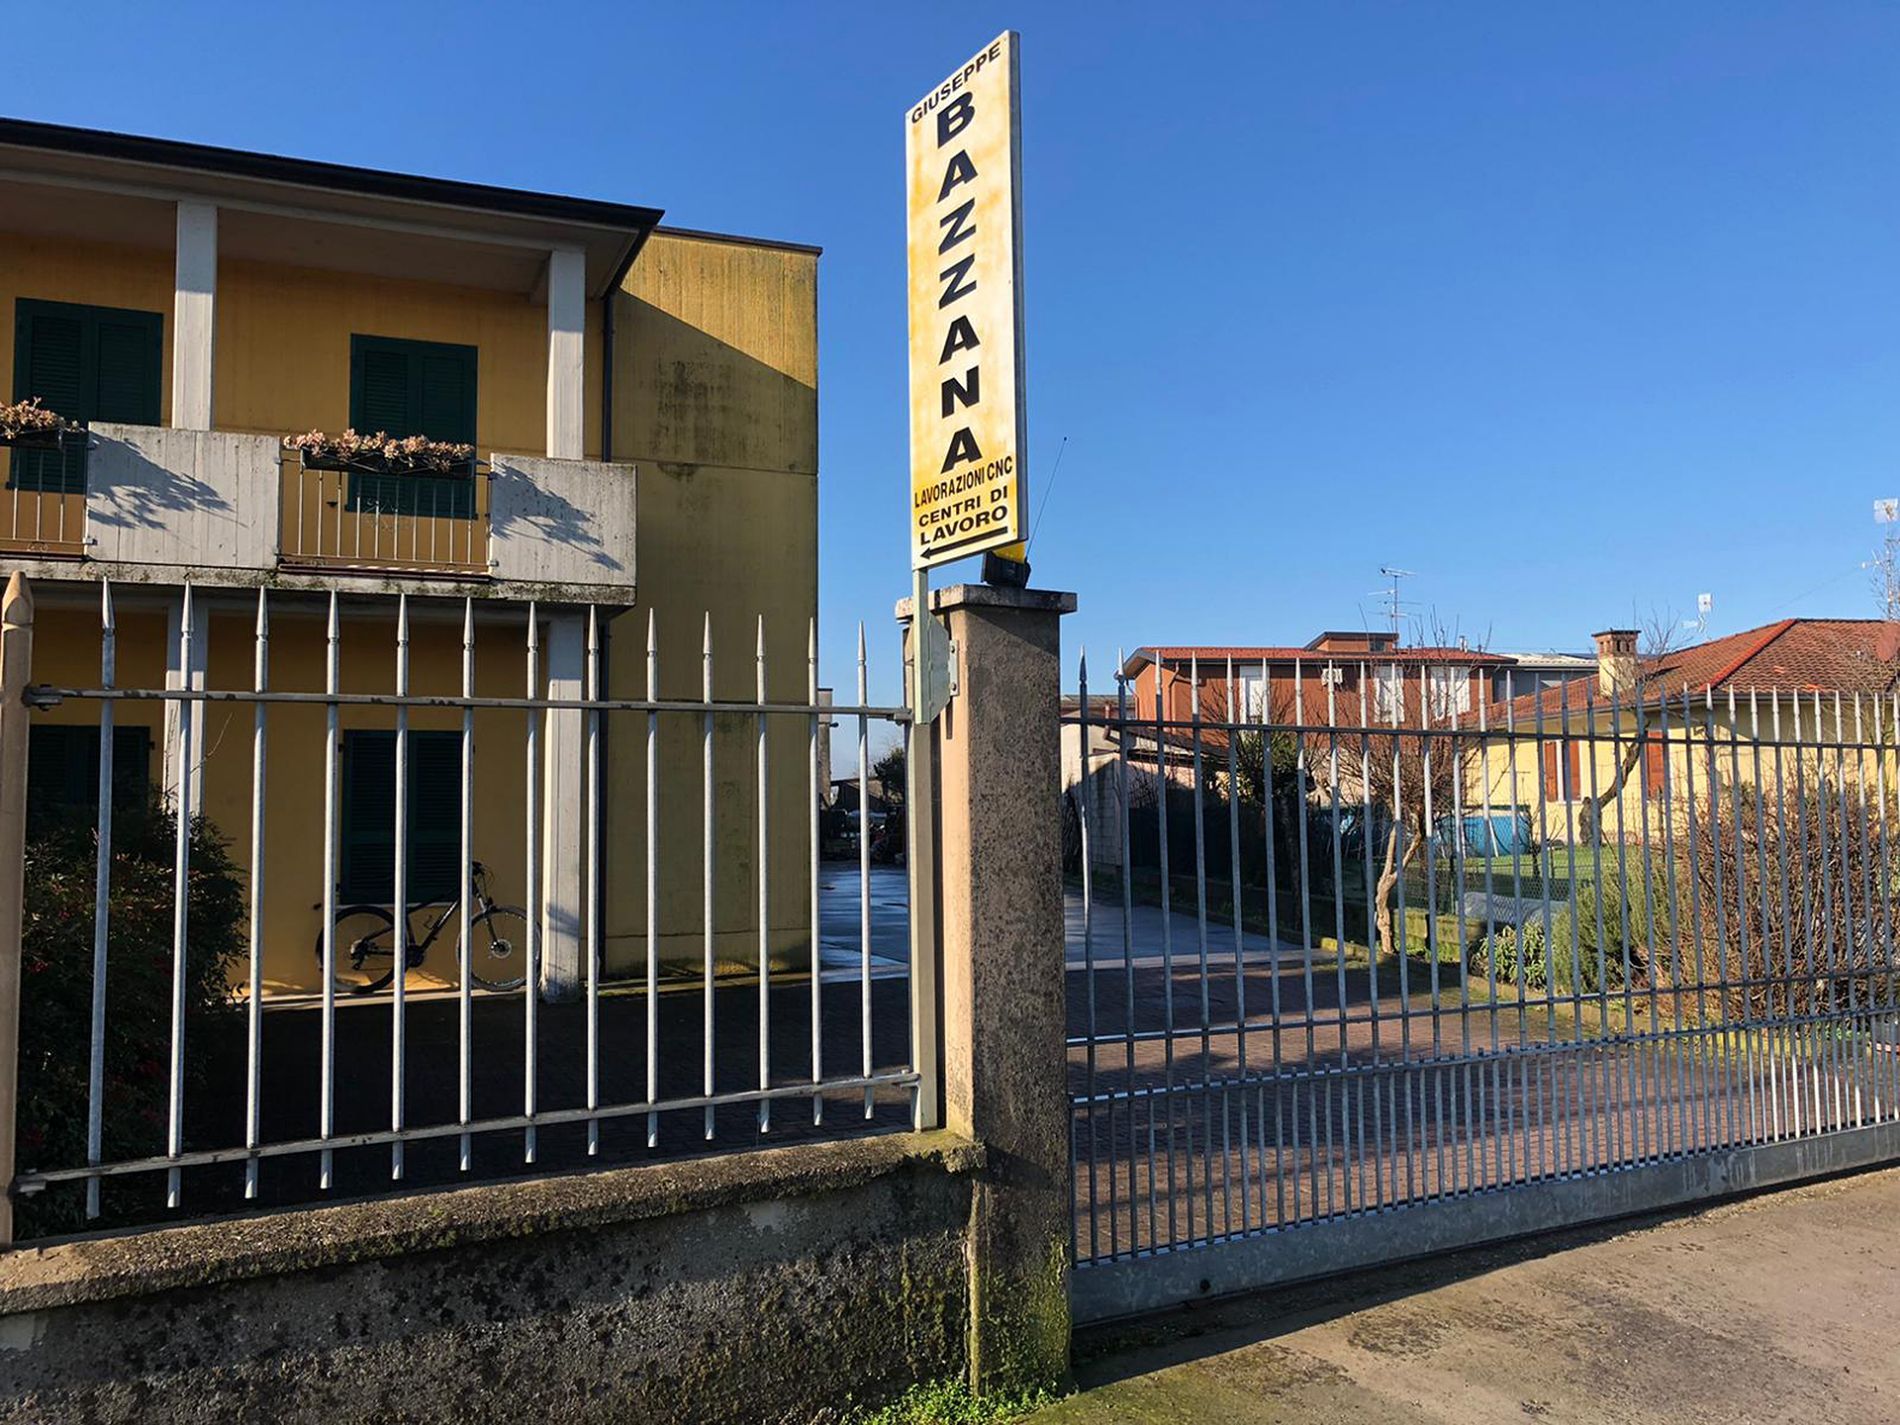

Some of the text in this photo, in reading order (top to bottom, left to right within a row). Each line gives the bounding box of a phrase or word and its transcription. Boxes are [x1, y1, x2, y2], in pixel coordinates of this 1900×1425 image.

[911, 41, 1001, 124] GIUSEPPE
[937, 91, 983, 474] BAZZANA
[914, 455, 1013, 508] LAVORAZIONI CNC
[919, 485, 1008, 527] CENTRI DI
[920, 505, 1008, 545] LAVORO
